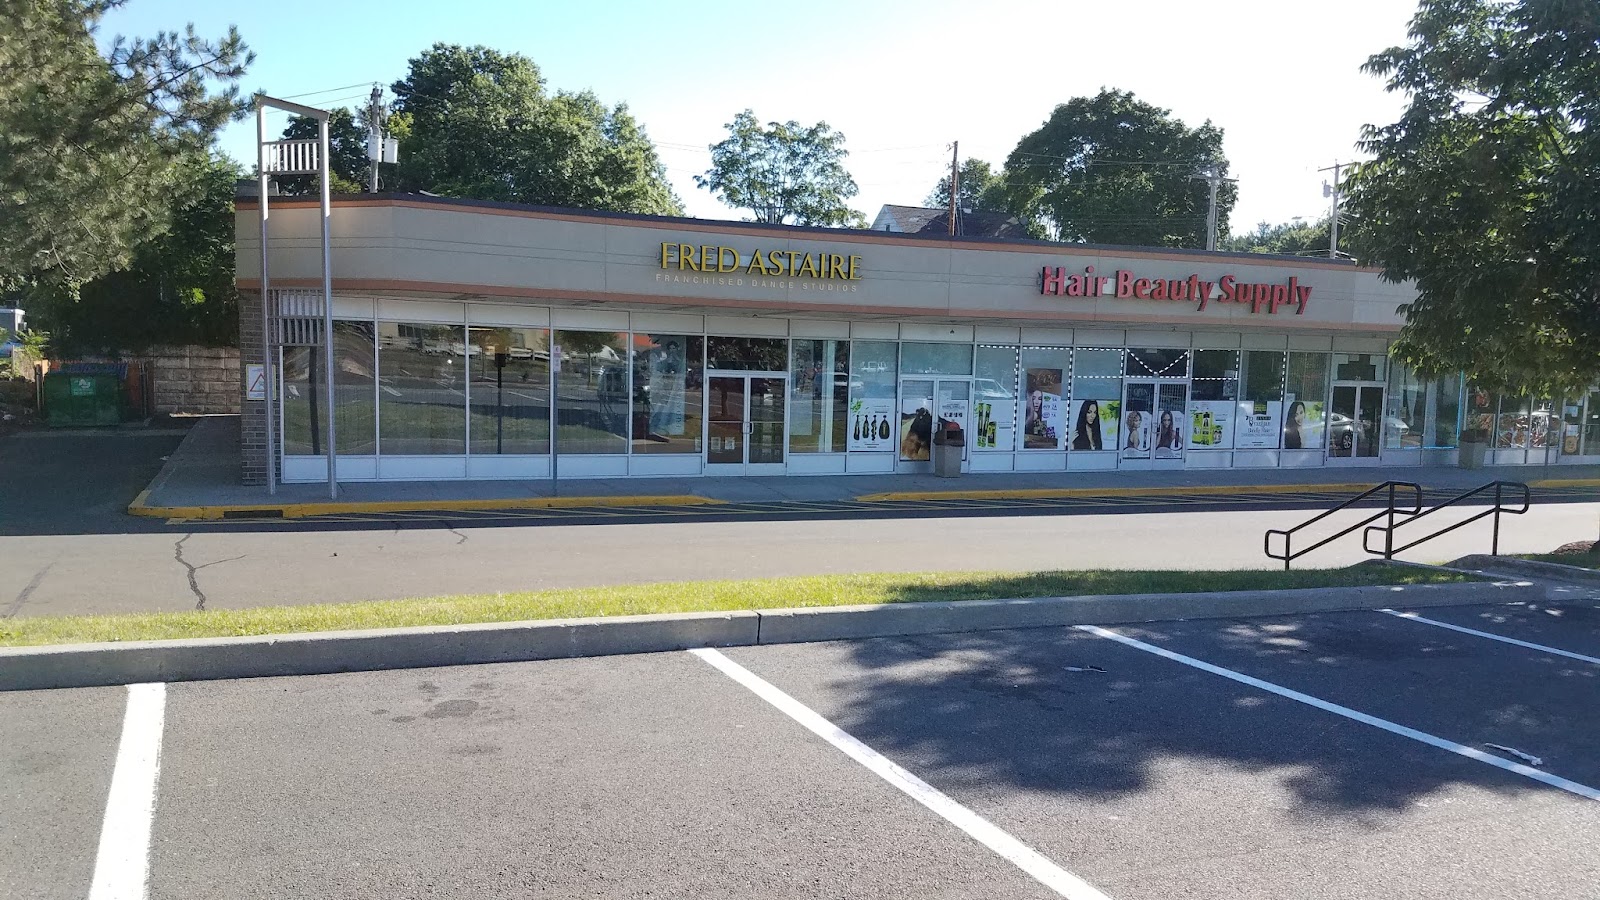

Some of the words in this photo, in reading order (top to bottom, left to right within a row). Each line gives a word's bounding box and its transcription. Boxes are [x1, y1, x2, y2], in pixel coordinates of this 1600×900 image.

[660, 242, 740, 273] FRED
[746, 249, 863, 281] ASTAIRE
[656, 273, 743, 287] FRANCHISED
[751, 279, 794, 290] DANCE
[802, 282, 858, 293] STUDIOS
[1041, 265, 1108, 297] Hair
[1116, 269, 1215, 312] Beauty
[1218, 274, 1313, 315] Supply
